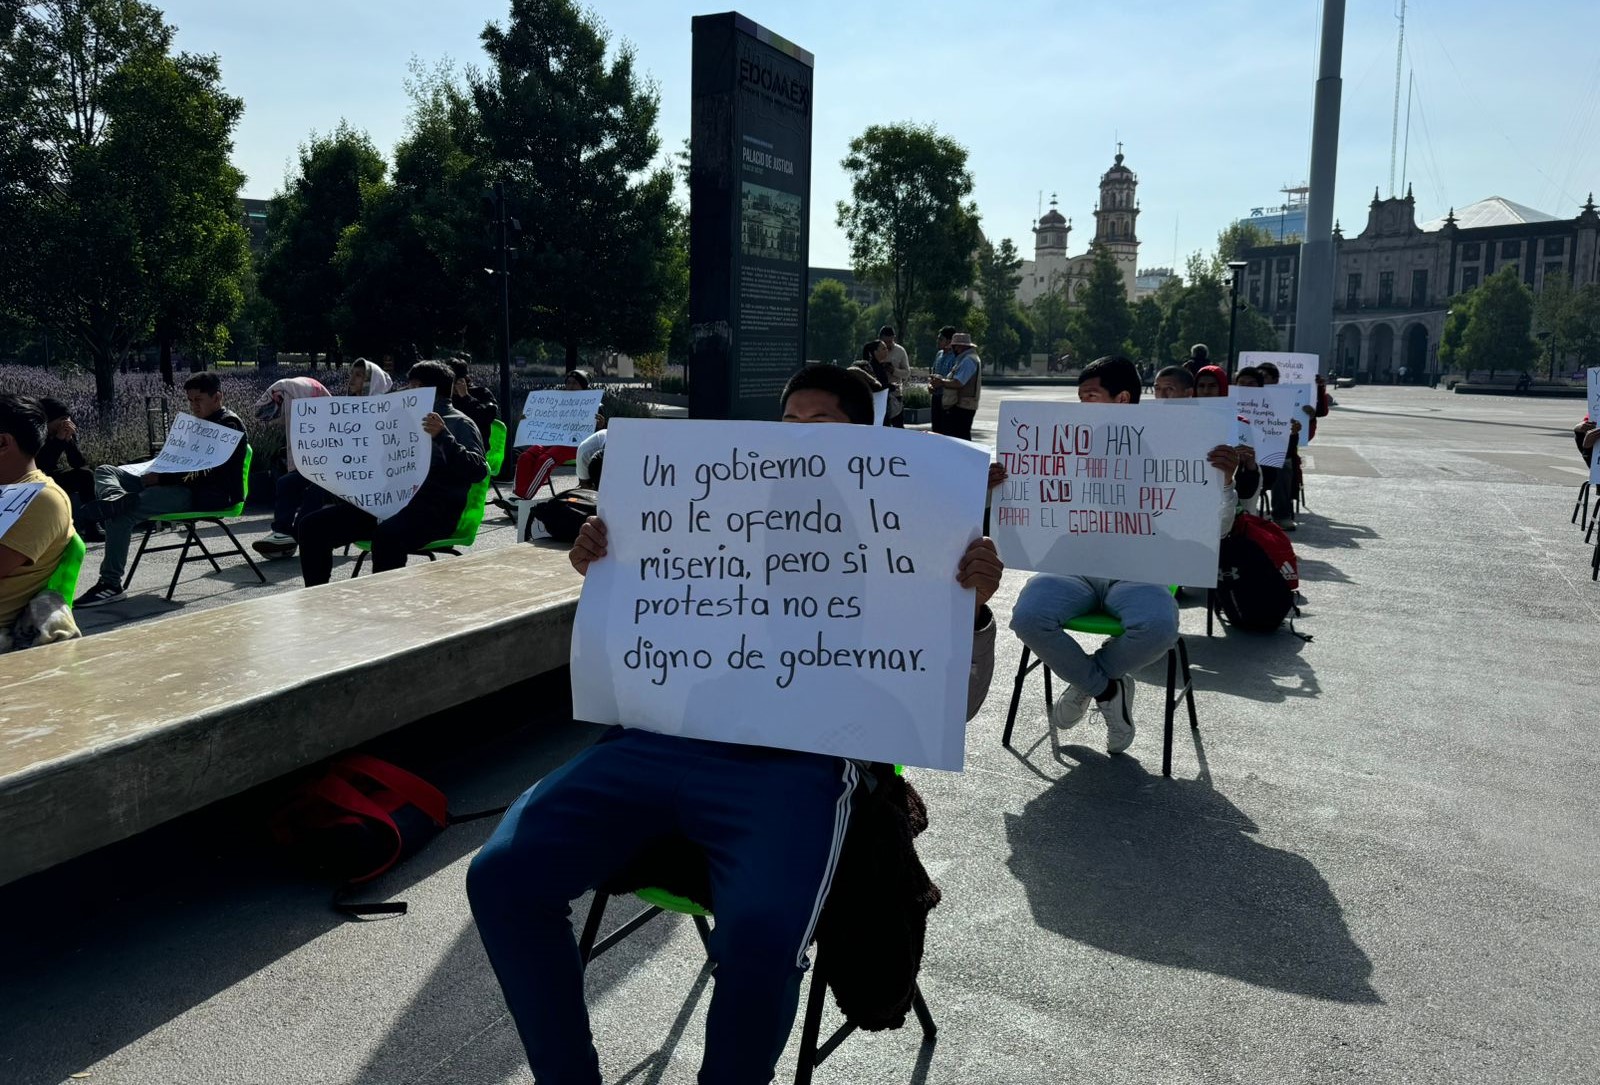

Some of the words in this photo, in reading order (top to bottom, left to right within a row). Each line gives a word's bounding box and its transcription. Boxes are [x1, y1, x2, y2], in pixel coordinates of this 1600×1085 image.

[742, 146, 765, 166] PALACIO
[765, 154, 772, 168] DE
[772, 156, 794, 175] JUSTICIA
[297, 403, 317, 417] UN
[330, 401, 391, 415] DERECHO
[402, 396, 418, 409] NO
[185, 420, 220, 440] pobreza
[298, 437, 344, 450] ALGUIEN
[352, 436, 369, 447] TE
[409, 432, 419, 443] ES
[299, 422, 315, 434] ES
[328, 422, 361, 434] ALGO
[375, 419, 399, 431] QUE
[1052, 423, 1093, 456] NO
[1106, 425, 1145, 456] HAY
[301, 455, 328, 466] ALGO
[342, 455, 368, 464] QUE
[388, 446, 416, 462] NADIE
[311, 472, 327, 482] TE
[335, 470, 375, 481] PUEDE
[386, 461, 417, 478] QUITAR
[643, 455, 675, 487] Un
[691, 448, 826, 501] gobierno
[848, 453, 910, 490] que
[1076, 457, 1108, 479] PARA
[1114, 458, 1132, 480] EL
[1143, 458, 1208, 486] PUEBLO,
[3, 488, 38, 515] LA
[1040, 479, 1072, 503] NO
[1082, 482, 1126, 506] HALLA
[1140, 487, 1177, 511] PAZ
[641, 510, 673, 533] no
[689, 501, 712, 533] le
[727, 499, 842, 542] ofenda
[870, 499, 901, 531] la
[999, 507, 1030, 526] PARA
[1041, 508, 1059, 528] EL
[640, 545, 751, 581] miseria,
[765, 551, 829, 586] pero
[842, 543, 867, 574] si
[886, 547, 915, 574] la
[635, 584, 769, 624] protesta
[783, 596, 818, 618] no
[827, 594, 861, 619] es
[624, 636, 712, 686] digno
[727, 634, 766, 670] de
[776, 631, 926, 688] gobernar.
